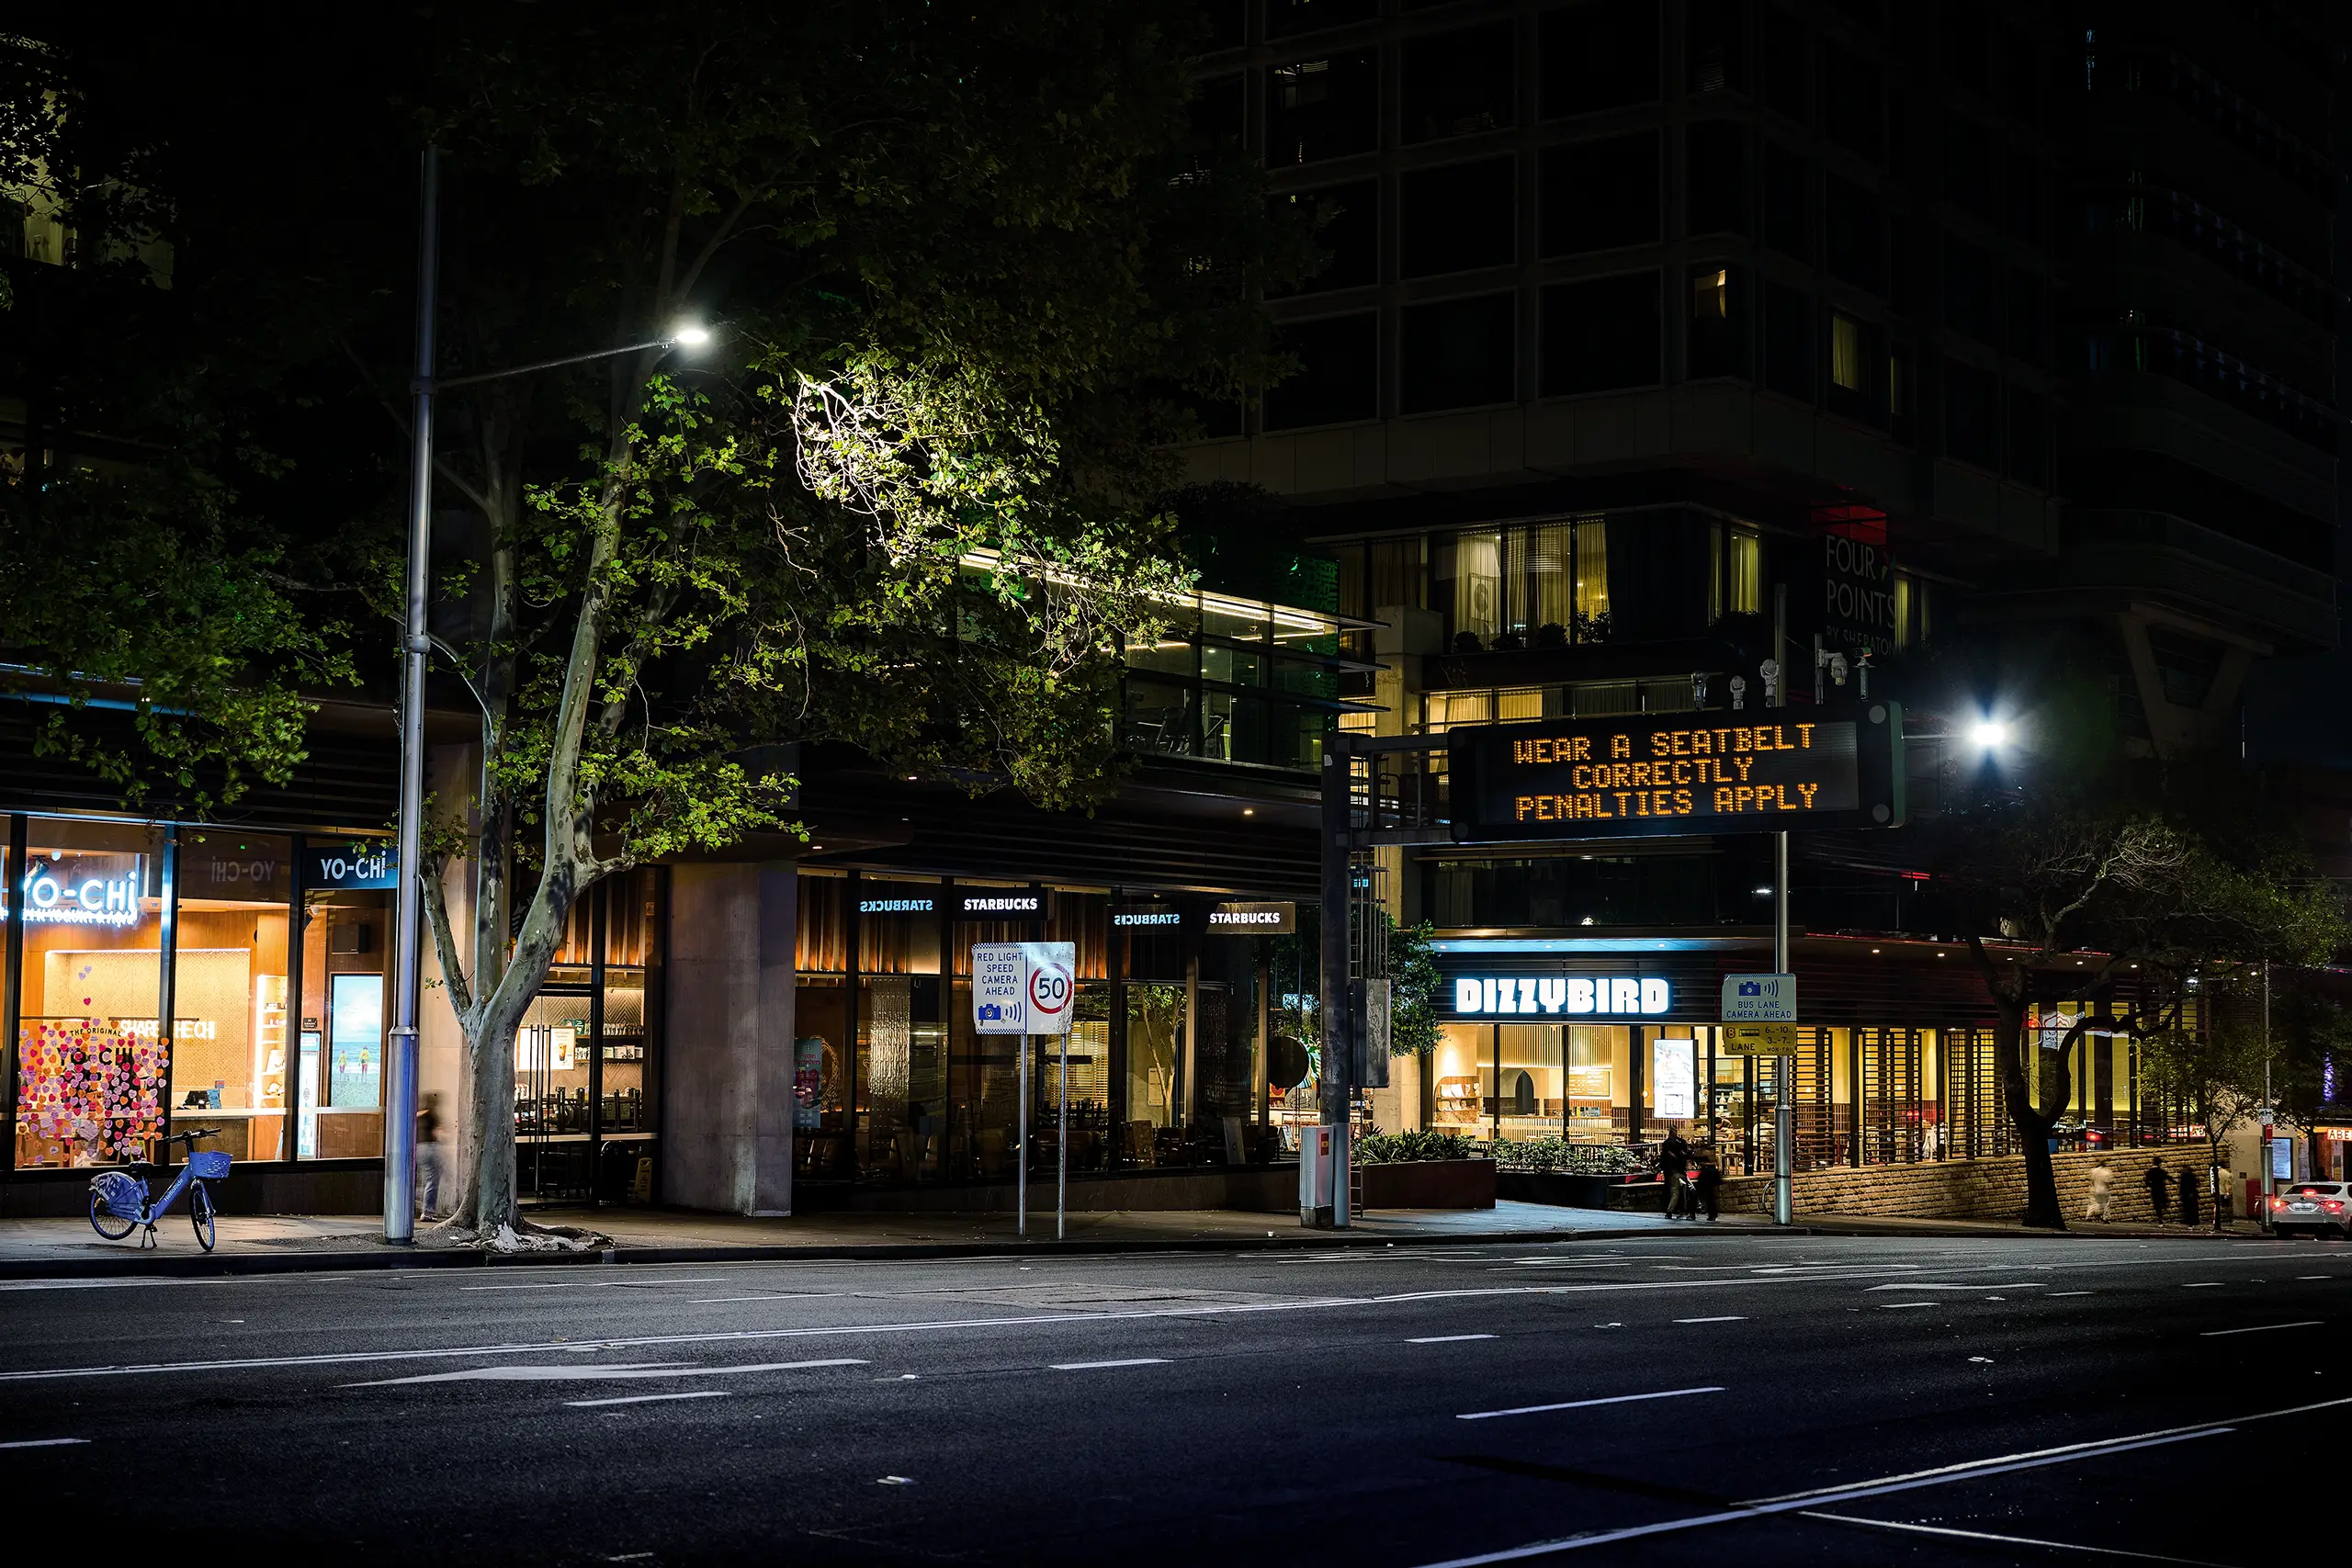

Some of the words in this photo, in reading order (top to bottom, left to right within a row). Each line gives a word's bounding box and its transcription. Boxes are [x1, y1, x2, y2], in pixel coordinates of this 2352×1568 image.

[1826, 534, 1876, 580] FOUR
[1826, 579, 1895, 630] POINTS
[1513, 736, 1591, 764] WEAR
[1611, 734, 1631, 759] A
[1651, 723, 1815, 757] SEATBELT
[1572, 756, 1754, 790] CORRECTLY
[1516, 788, 1693, 821] PENALTIES
[1713, 782, 1818, 813] APPLY
[964, 898, 1038, 910] STARBUCKS
[1209, 912, 1281, 924] STARBUCKS
[977, 953, 994, 962] RED
[998, 953, 1023, 961] LIGHT
[986, 964, 1014, 973] SPEED
[981, 976, 1018, 984] CAMERA
[1038, 977, 1065, 999] 50
[985, 987, 1015, 996] AHEAD
[1455, 978, 1669, 1013] DIZZYBIRD
[1726, 1010, 1759, 1019] CAMERA
[1764, 1010, 1792, 1019] AHEAD
[70, 1029, 84, 1037] THE
[86, 1027, 121, 1037] ORIGINAL
[173, 1021, 194, 1039] HE
[164, 1179, 184, 1202] HelloRide
